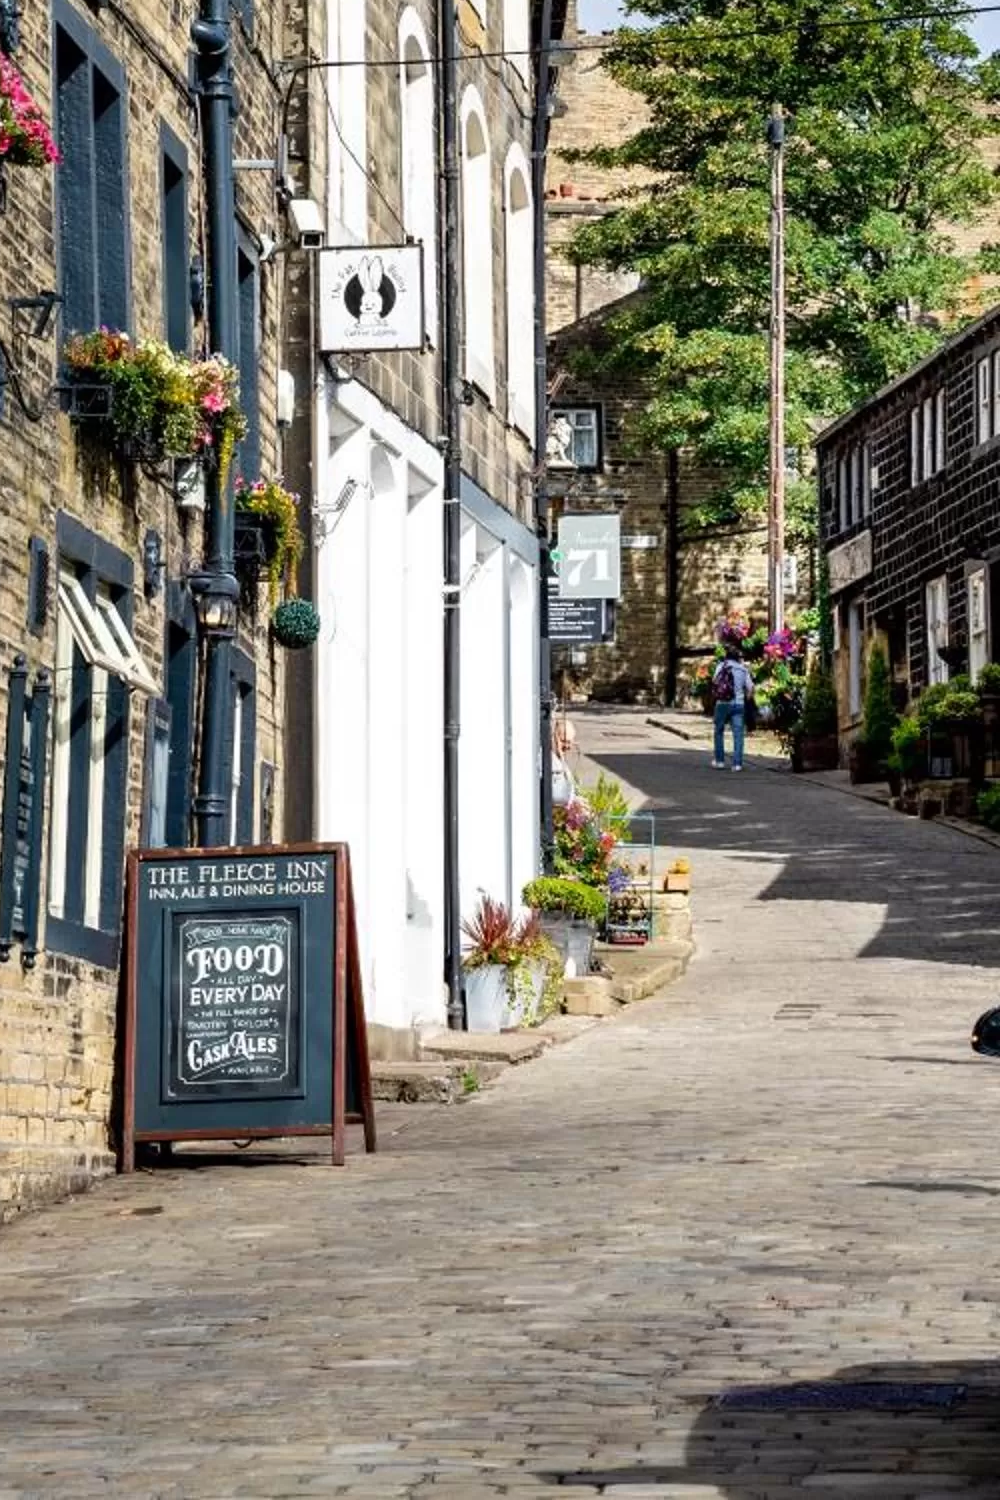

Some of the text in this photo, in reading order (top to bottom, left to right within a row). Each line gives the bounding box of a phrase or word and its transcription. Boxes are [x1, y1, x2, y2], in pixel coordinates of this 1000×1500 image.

[567, 548, 613, 588] 71
[148, 861, 328, 885] THE FLEECE INN
[149, 881, 325, 900] INN, ALE & DINING HOUSE
[186, 943, 284, 985] FOOD
[217, 974, 257, 985] ALL DAY
[190, 984, 285, 1006] EVERY DAY
[260, 1007, 270, 1015] OF
[187, 1029, 278, 1072] CASK ALES
